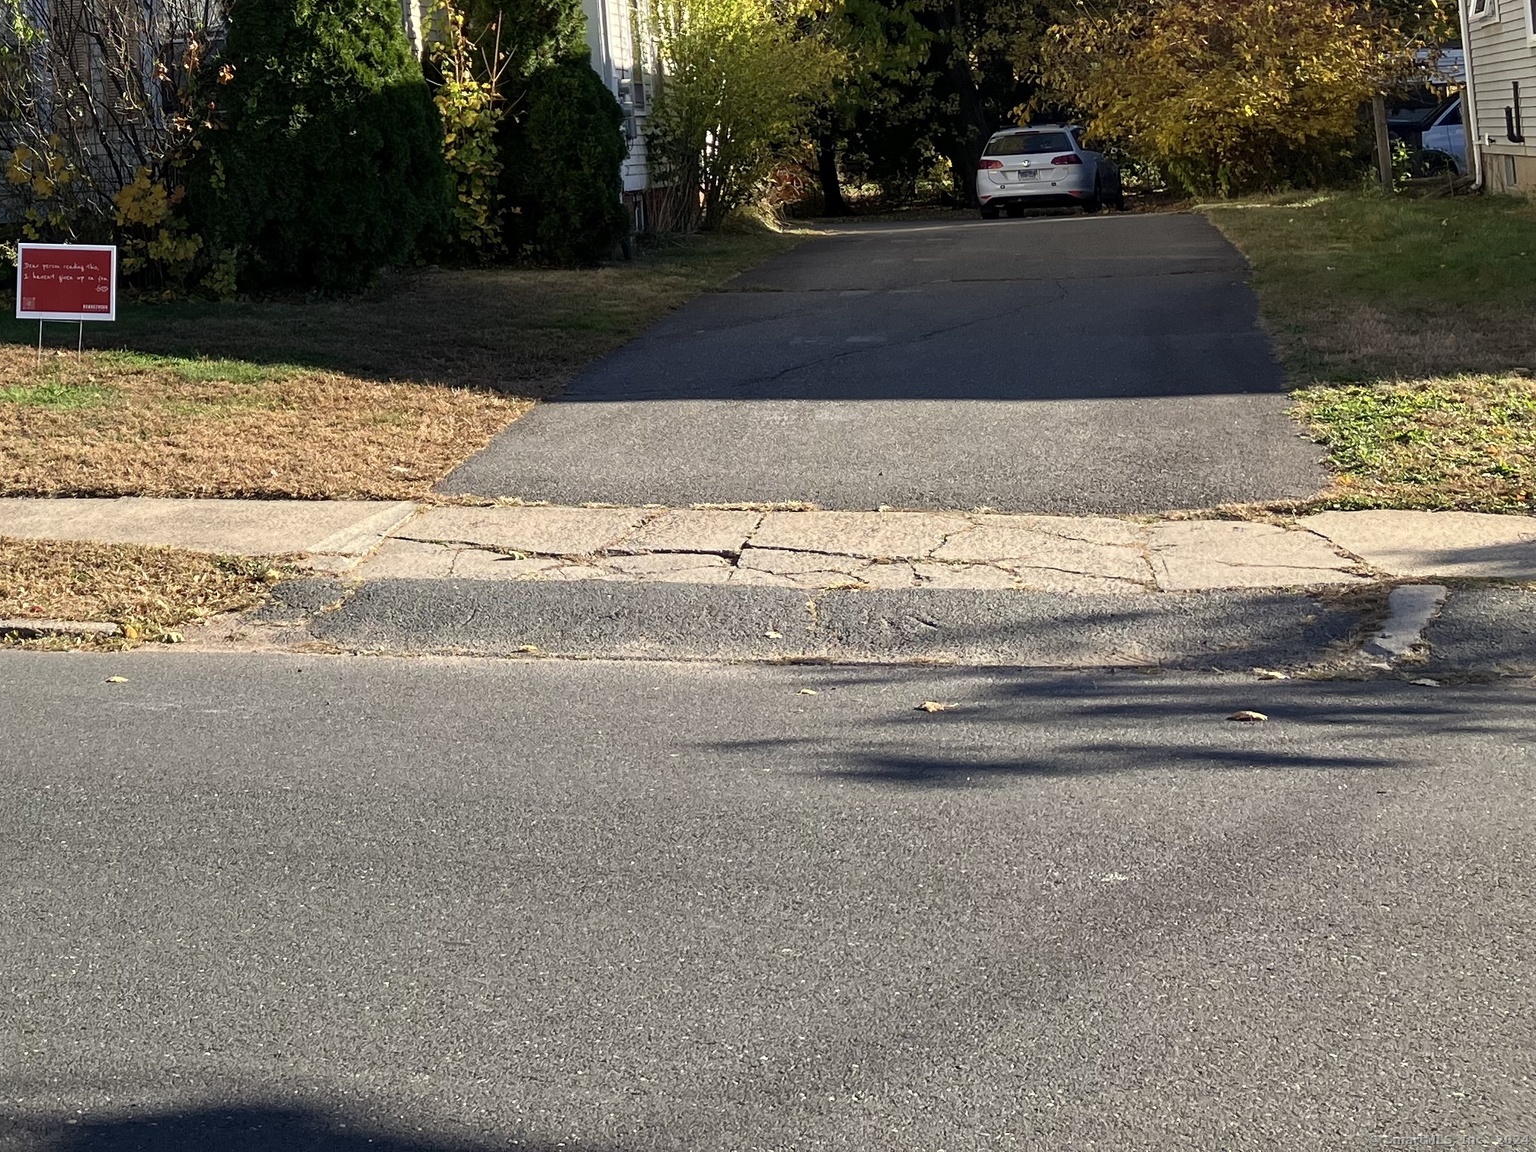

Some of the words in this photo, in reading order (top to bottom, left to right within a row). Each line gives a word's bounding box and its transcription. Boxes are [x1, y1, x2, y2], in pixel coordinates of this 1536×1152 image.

[63, 262, 84, 272] reading
[58, 274, 73, 283] given
[76, 275, 85, 283] up
[97, 275, 108, 283] you
